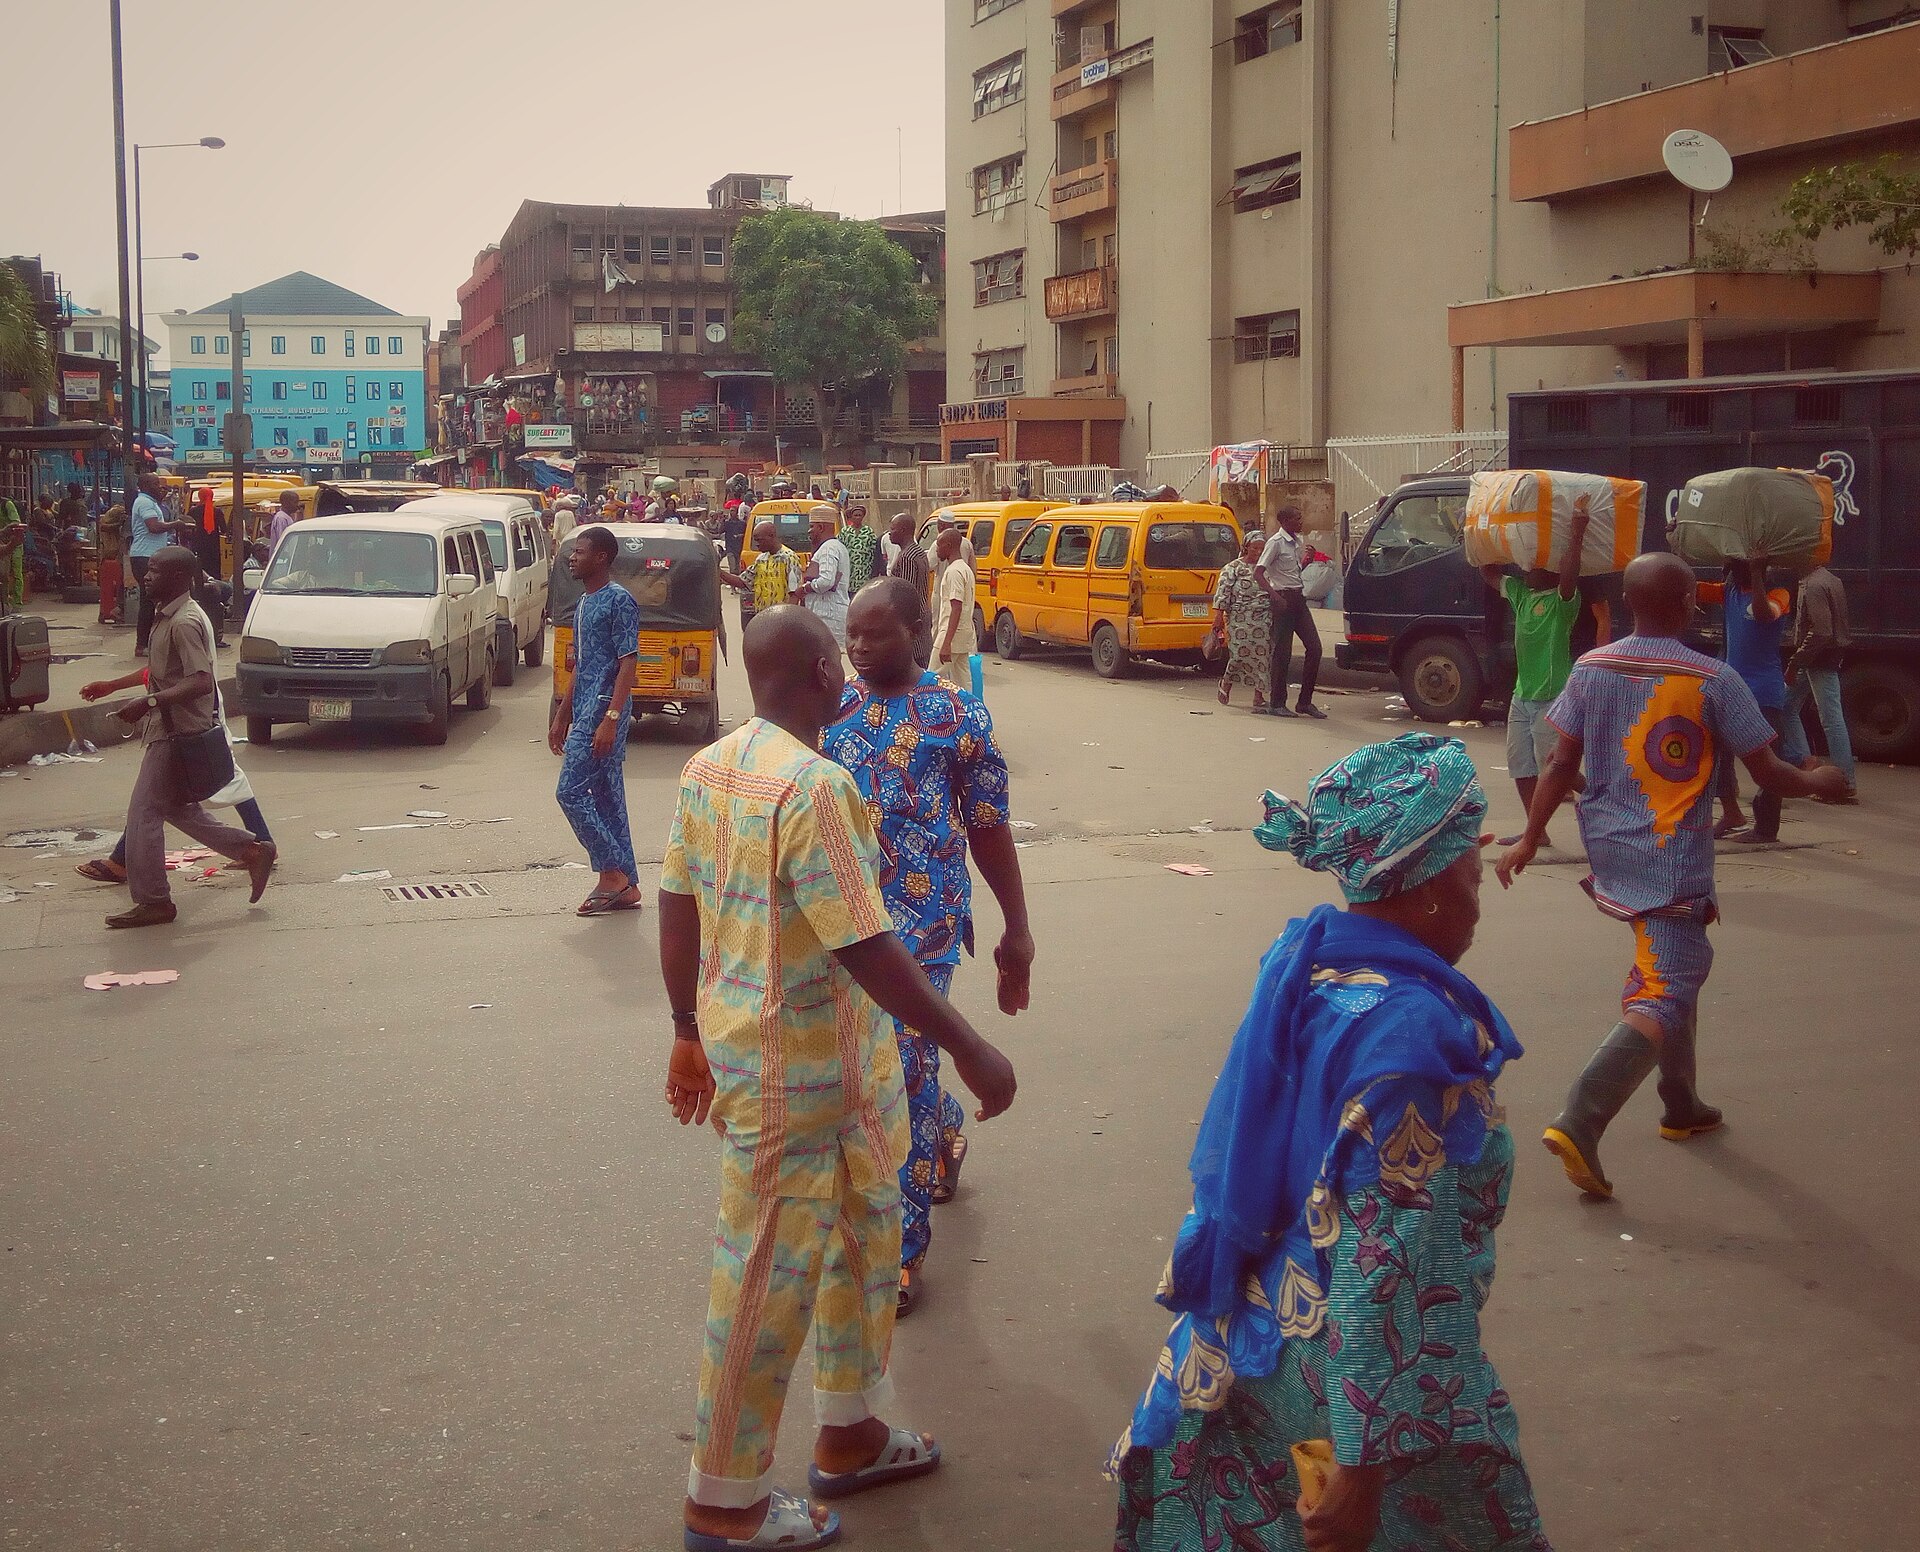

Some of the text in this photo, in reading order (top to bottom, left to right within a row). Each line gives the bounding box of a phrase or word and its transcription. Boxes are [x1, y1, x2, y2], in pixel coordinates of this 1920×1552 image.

[1083, 63, 1106, 79] brother
[978, 400, 1007, 420] HOUSE
[310, 449, 339, 459] Signal
